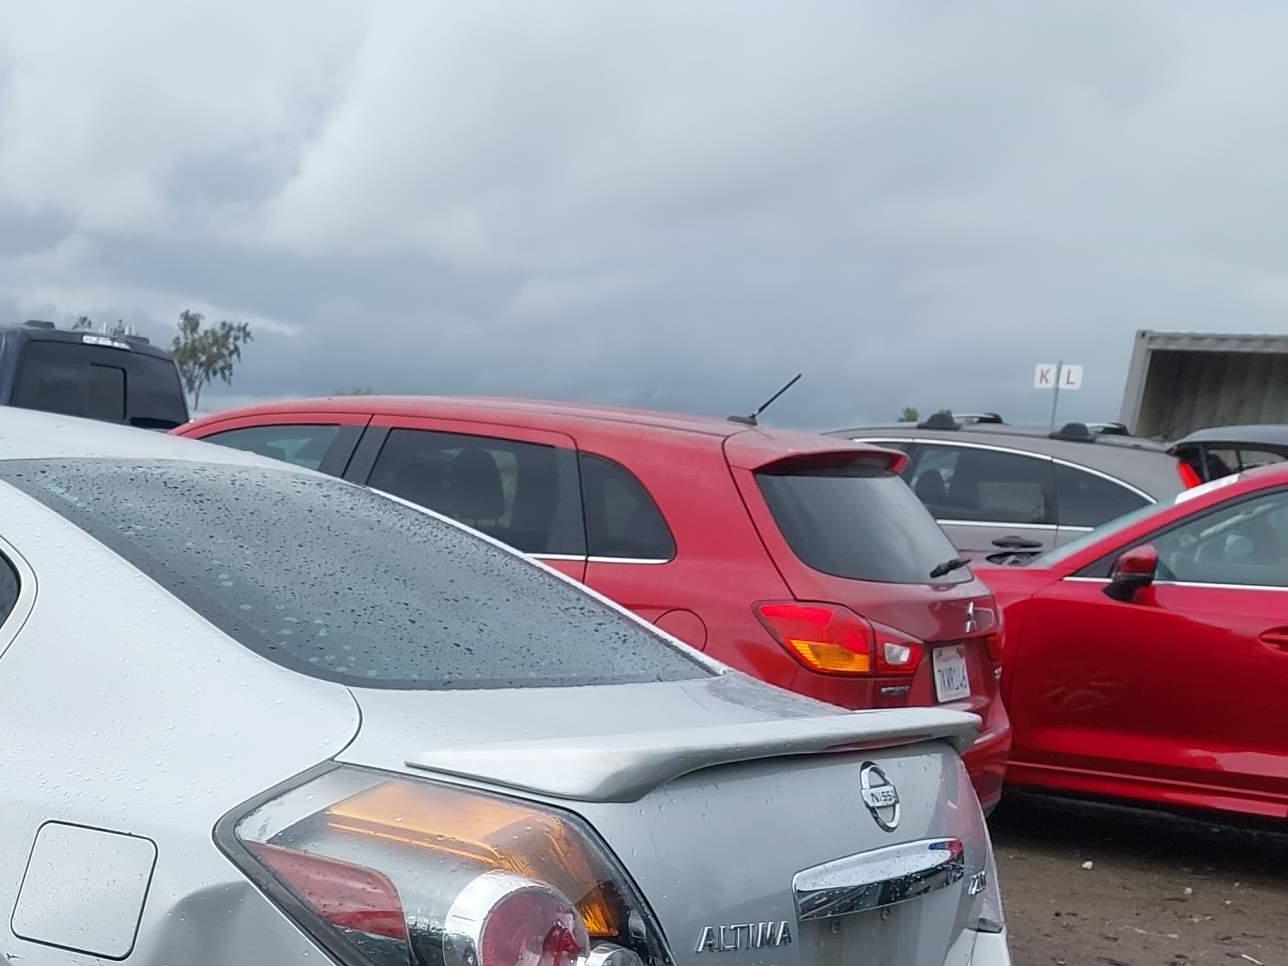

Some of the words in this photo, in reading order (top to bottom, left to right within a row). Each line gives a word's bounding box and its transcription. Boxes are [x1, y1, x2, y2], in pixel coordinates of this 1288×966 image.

[1039, 368, 1050, 384] K
[1066, 368, 1076, 385] L
[694, 920, 792, 953] ALTIMA
